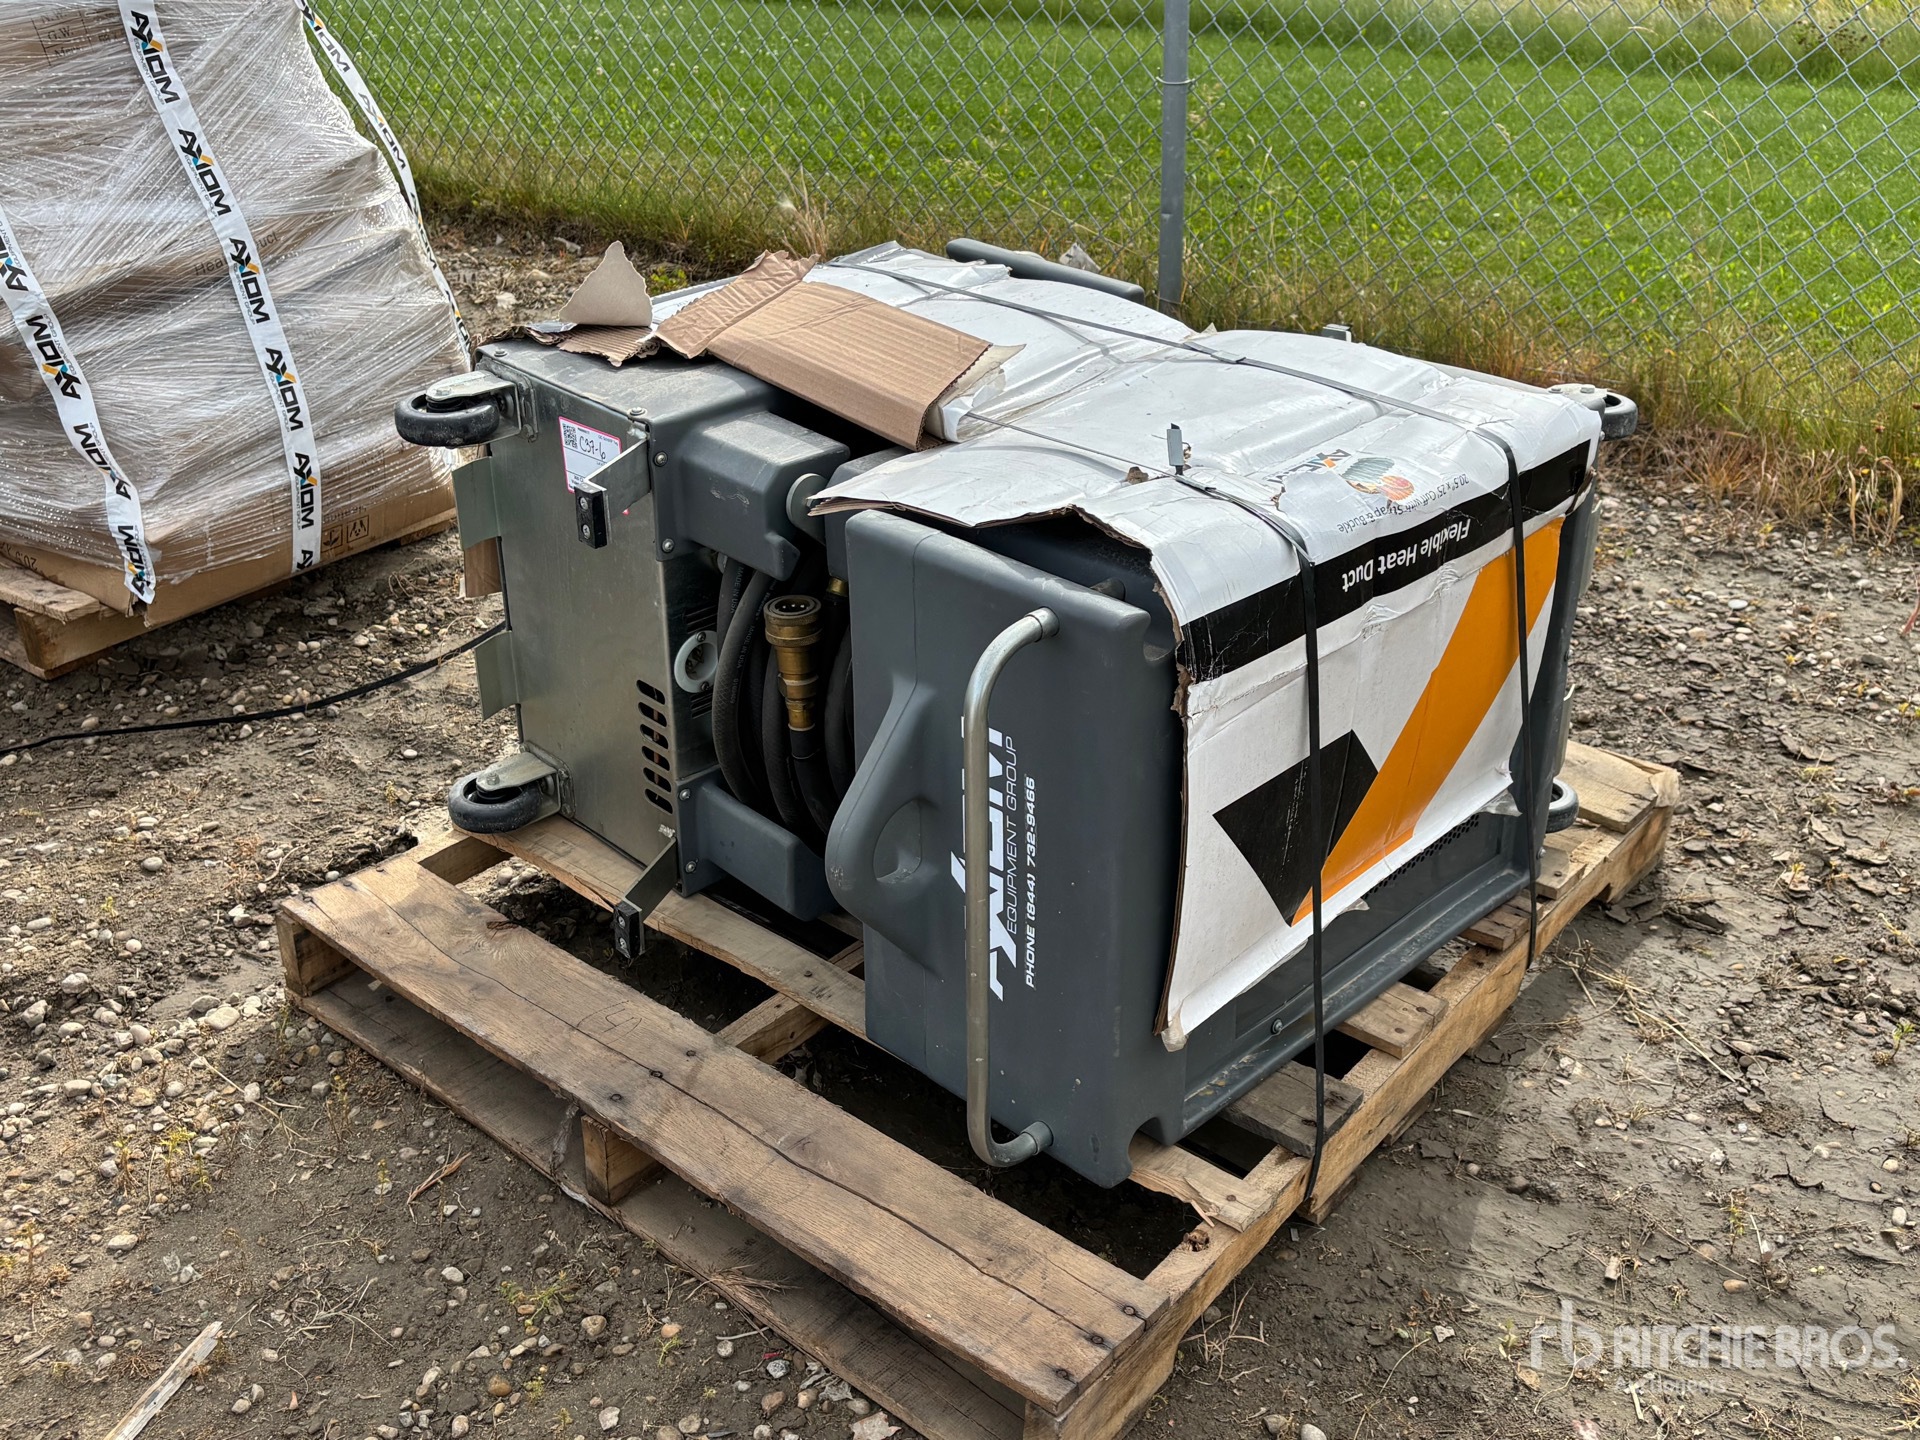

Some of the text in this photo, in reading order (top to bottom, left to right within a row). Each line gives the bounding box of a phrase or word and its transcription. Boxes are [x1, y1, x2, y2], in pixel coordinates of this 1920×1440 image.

[130, 10, 180, 104] AXIOM
[178, 129, 232, 216] AXIOM
[358, 92, 406, 169] AXIOM
[194, 230, 280, 276] Hea uct
[229, 237, 271, 324] AXIOM
[26, 315, 81, 399] AXIOM
[265, 347, 304, 431] AXIOM
[73, 423, 131, 500] AXIOM
[293, 452, 317, 529] AXIOM
[1336, 516, 1367, 534] Buckle
[1341, 519, 1471, 593] Flexible Heat Duct
[1005, 735, 1017, 935] EQUIPMENT GROUP
[1024, 776, 1036, 988] PHONE (844) 732-9466
